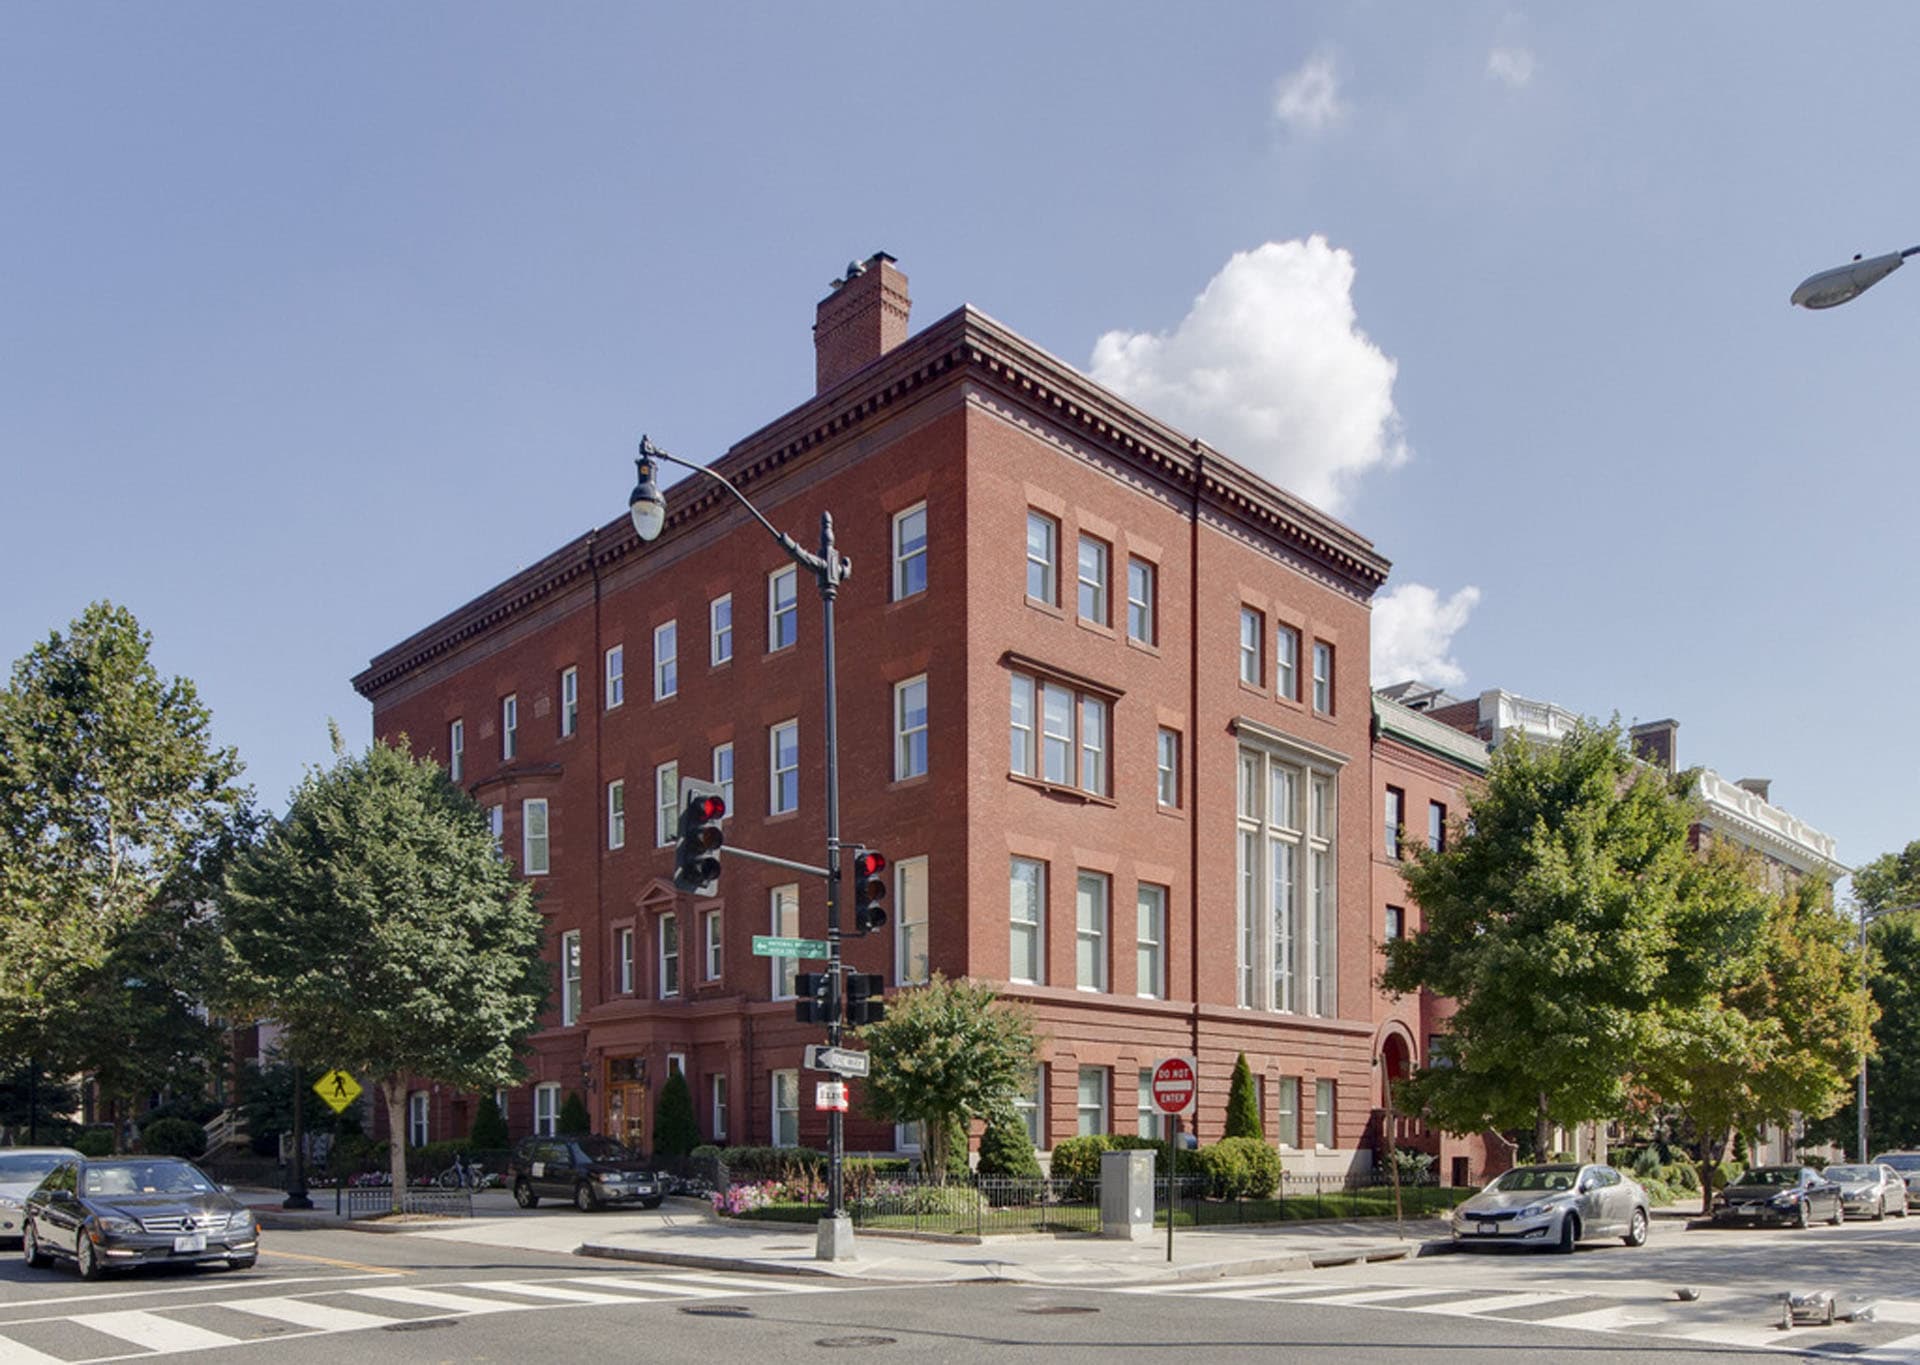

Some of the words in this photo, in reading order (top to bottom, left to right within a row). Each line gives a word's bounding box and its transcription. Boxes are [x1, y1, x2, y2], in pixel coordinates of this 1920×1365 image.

[1158, 1069, 1170, 1078] DO
[1173, 1068, 1189, 1078] NOT
[1161, 1093, 1185, 1103] ENTER
